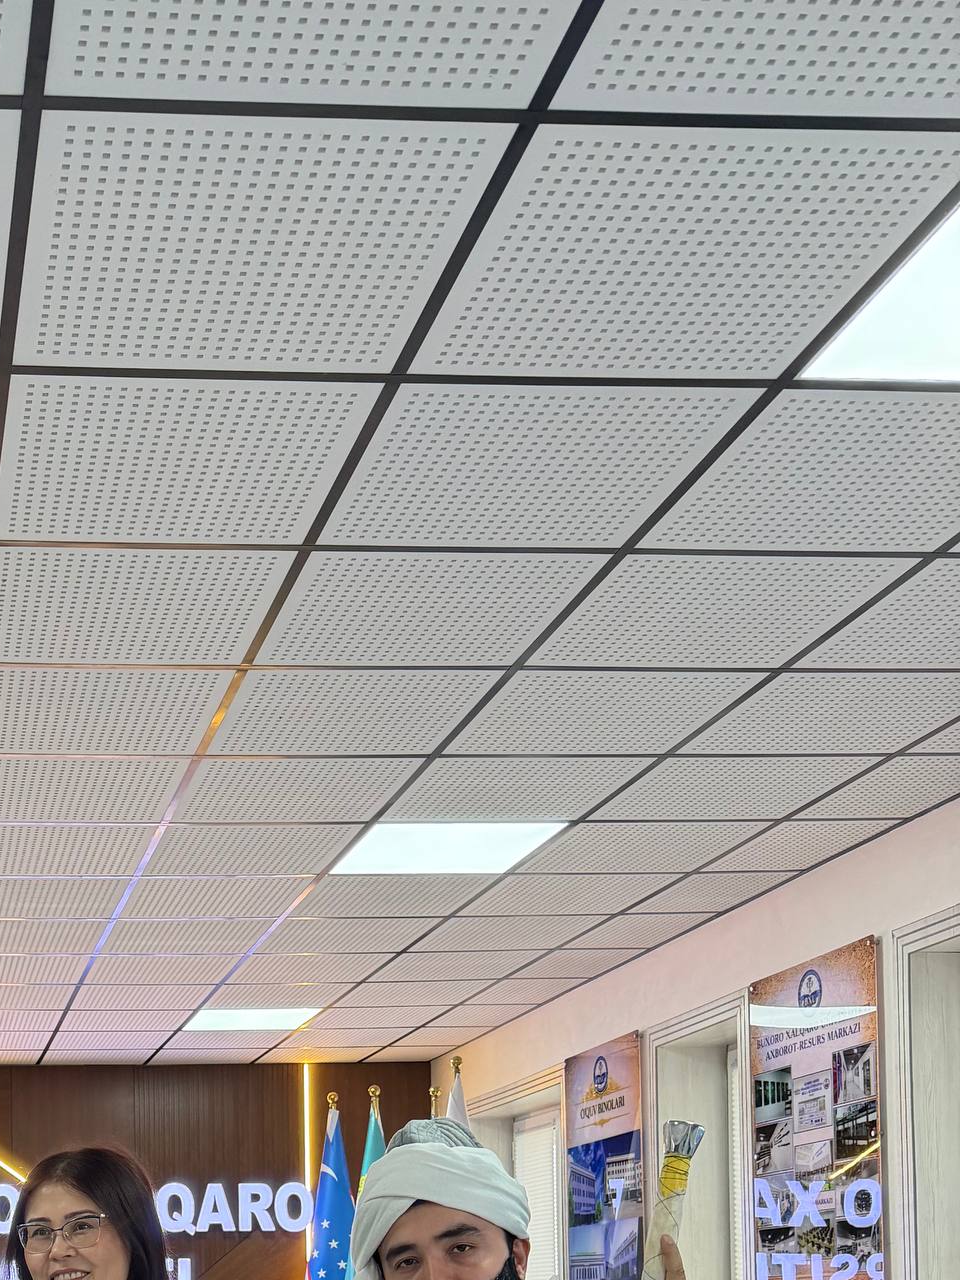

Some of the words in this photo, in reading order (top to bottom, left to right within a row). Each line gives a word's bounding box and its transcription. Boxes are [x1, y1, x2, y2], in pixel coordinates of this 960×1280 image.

[827, 1022, 861, 1041] MARKAZI
[598, 1095, 625, 1115] BINOLARI
[155, 1181, 315, 1236] QARO
